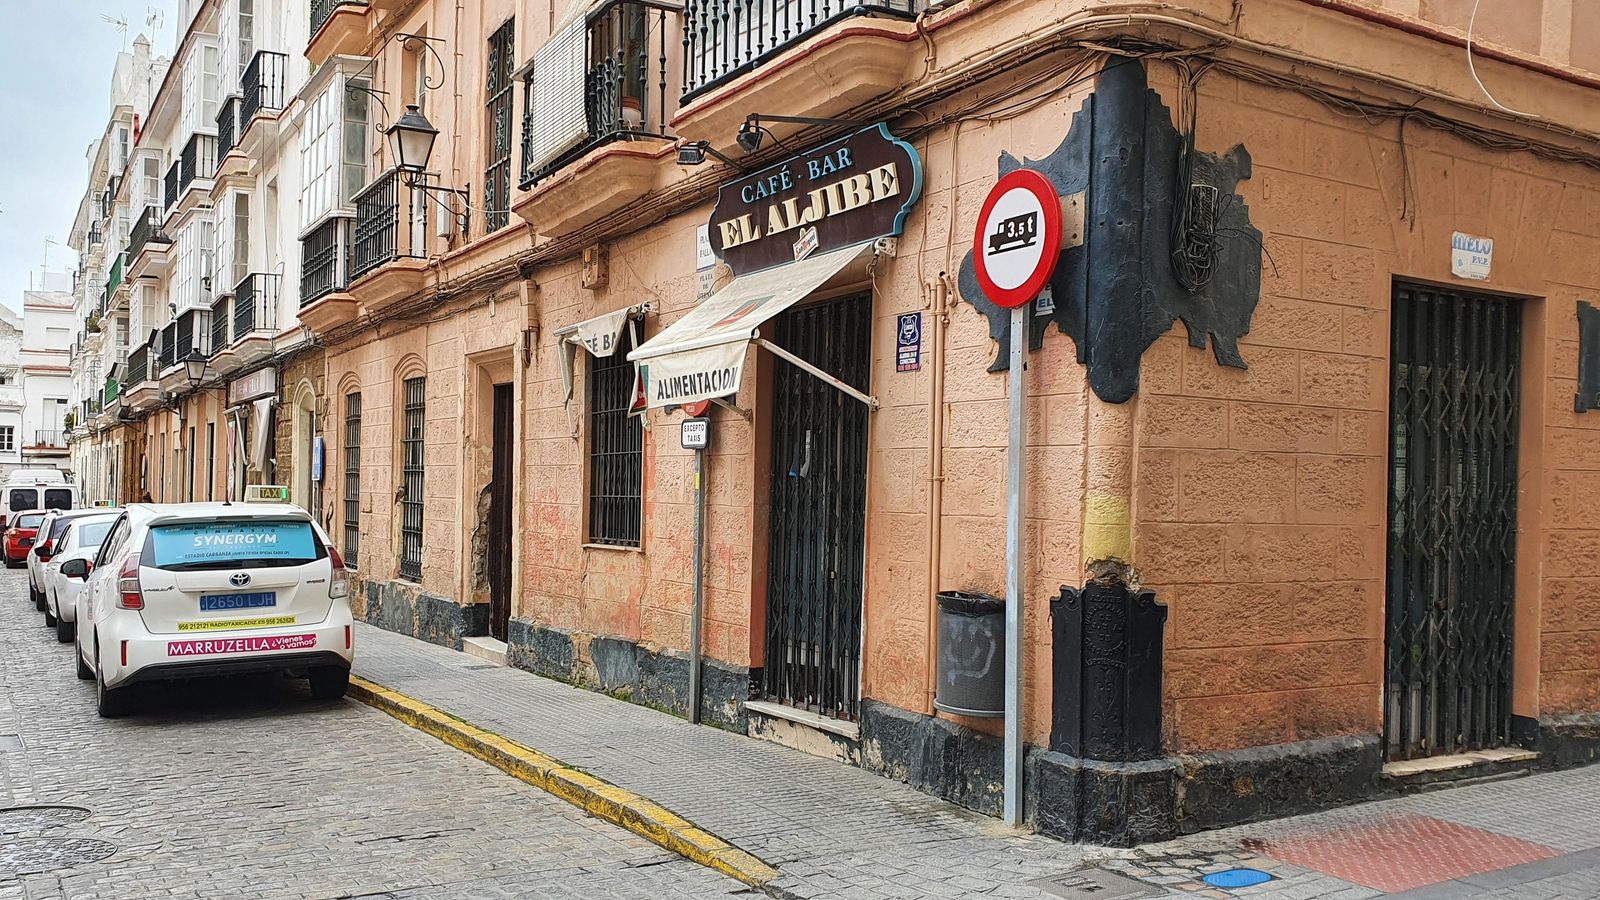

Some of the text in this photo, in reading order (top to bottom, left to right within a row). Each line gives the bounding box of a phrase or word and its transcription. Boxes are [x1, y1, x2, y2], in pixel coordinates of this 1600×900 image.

[741, 147, 854, 204] CAFÉ BAR
[717, 162, 901, 251] EL ALJIBE
[657, 366, 738, 401] ALIMENTACION
[684, 424, 705, 433] EXCEPTO
[687, 434, 701, 443] TAXIS
[193, 533, 277, 547] SYNERGYM
[208, 593, 274, 610] 2650 LJH
[178, 623, 189, 631] 956
[189, 622, 209, 630] 212121
[265, 618, 276, 626] 956
[168, 639, 270, 656] MARRUZELLA
[272, 636, 303, 648] ¿Vienes
[286, 637, 317, 650] vamos?
